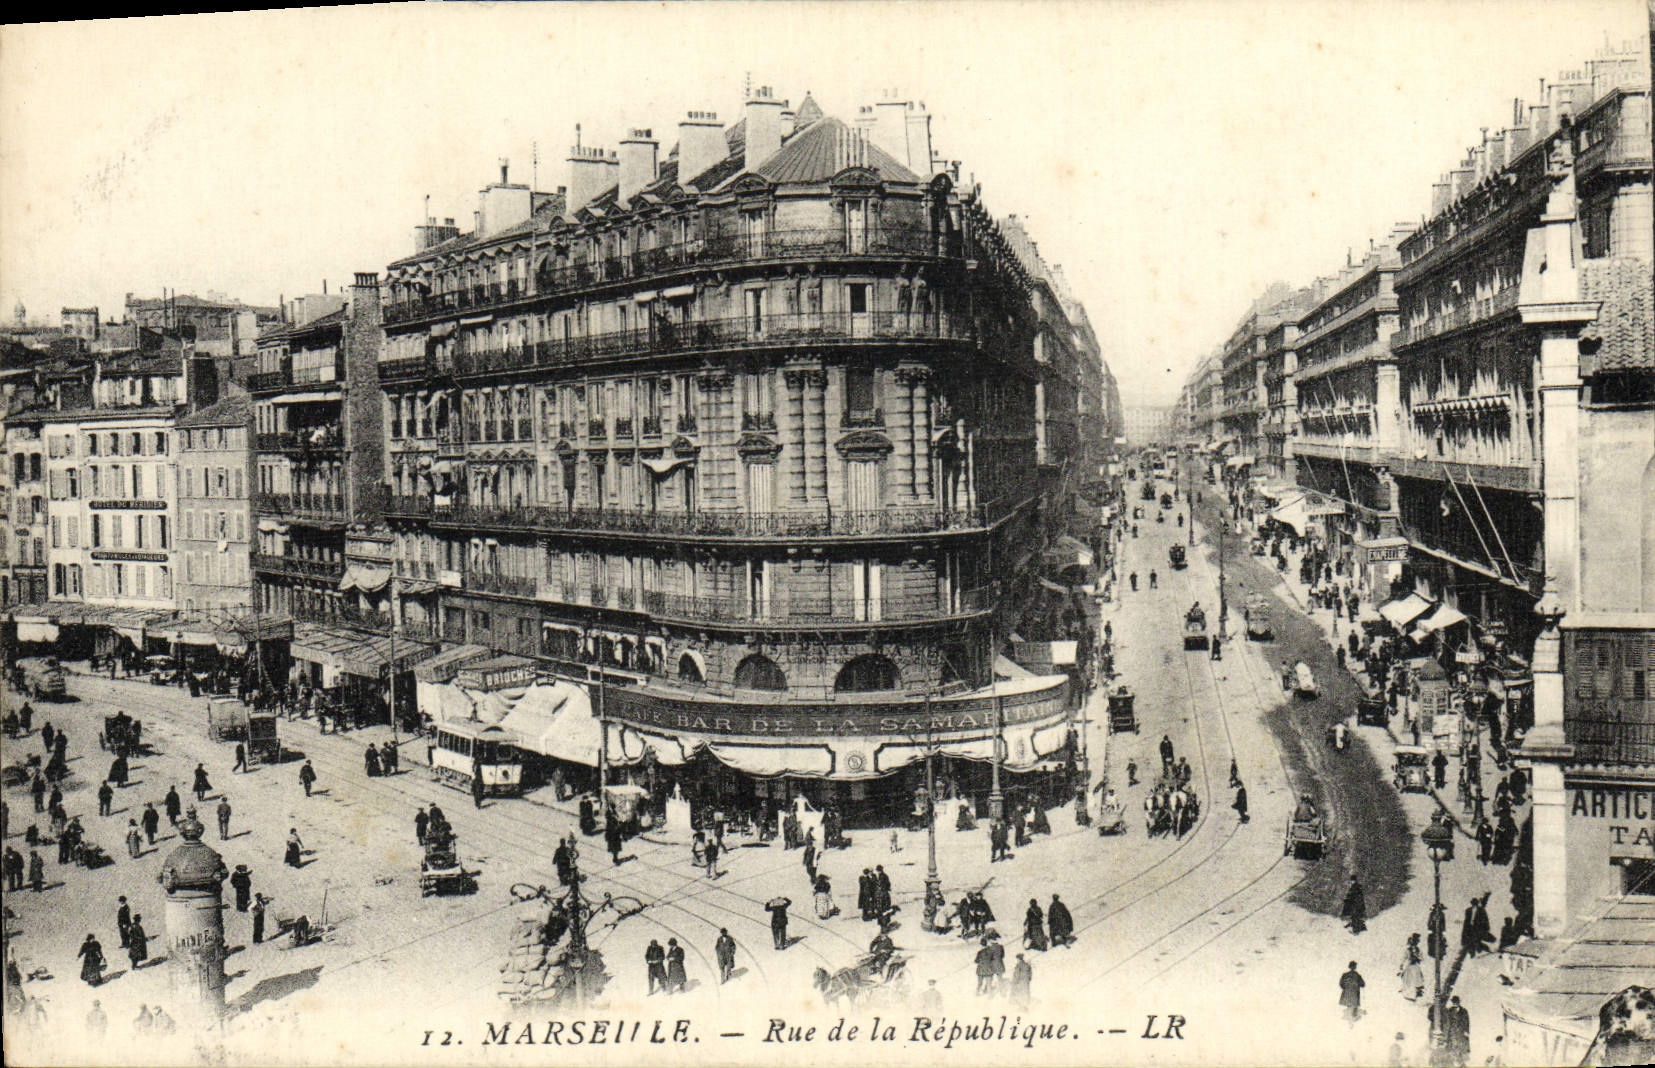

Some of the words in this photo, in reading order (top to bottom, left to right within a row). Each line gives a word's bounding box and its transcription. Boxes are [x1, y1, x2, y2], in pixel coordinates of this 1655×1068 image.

[677, 714, 732, 730] BAR
[752, 719, 793, 732] DE
[815, 719, 859, 732] LA
[1608, 824, 1655, 848] TA
